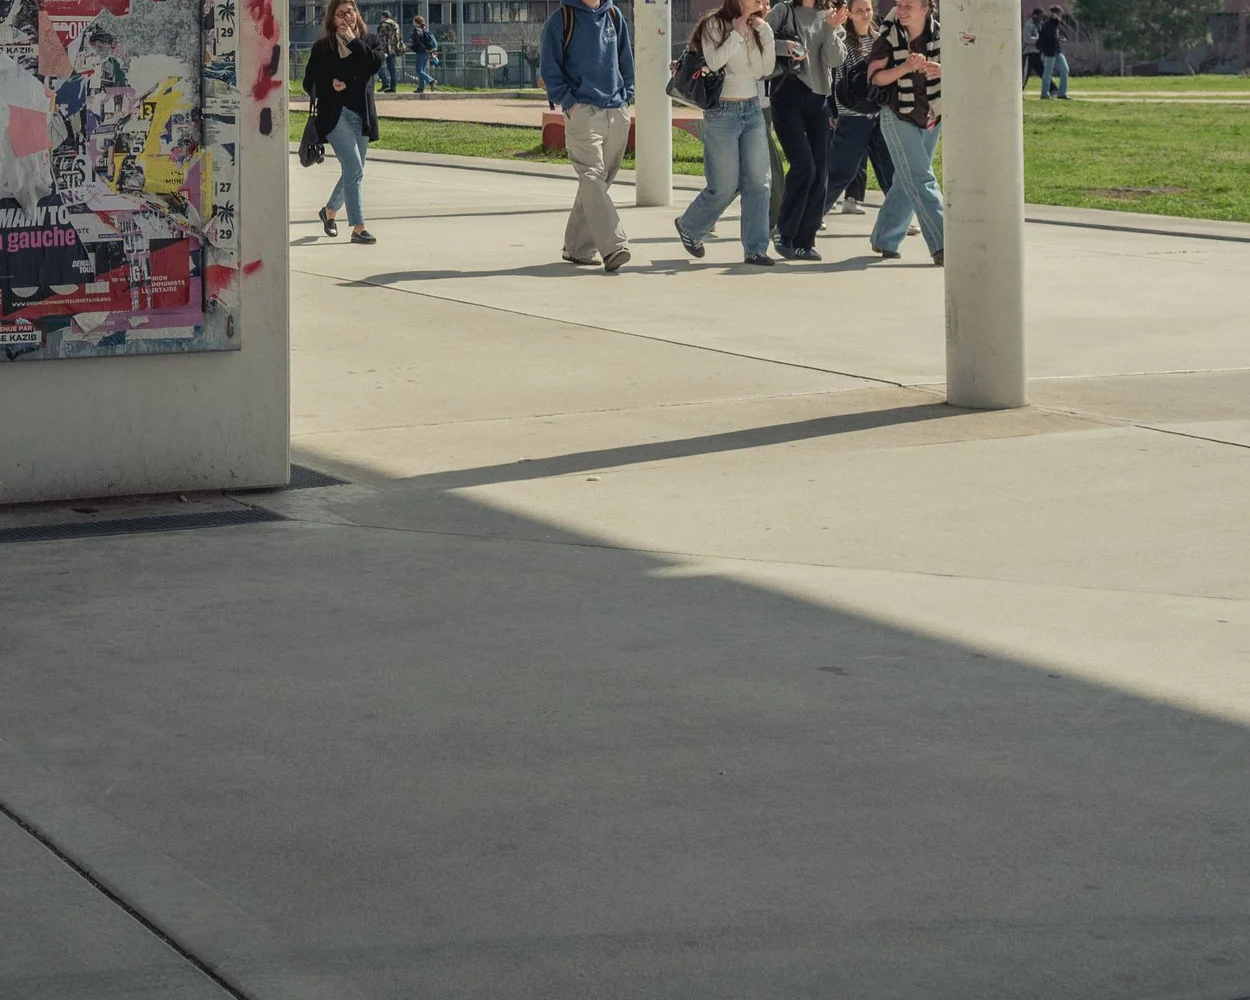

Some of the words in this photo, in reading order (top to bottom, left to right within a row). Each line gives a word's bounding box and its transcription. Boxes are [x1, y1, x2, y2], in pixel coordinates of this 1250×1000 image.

[220, 27, 233, 38] 29
[219, 182, 231, 192] 27
[7, 226, 76, 252] gauche
[219, 229, 232, 239] 29
[9, 333, 38, 342] KAZIB
